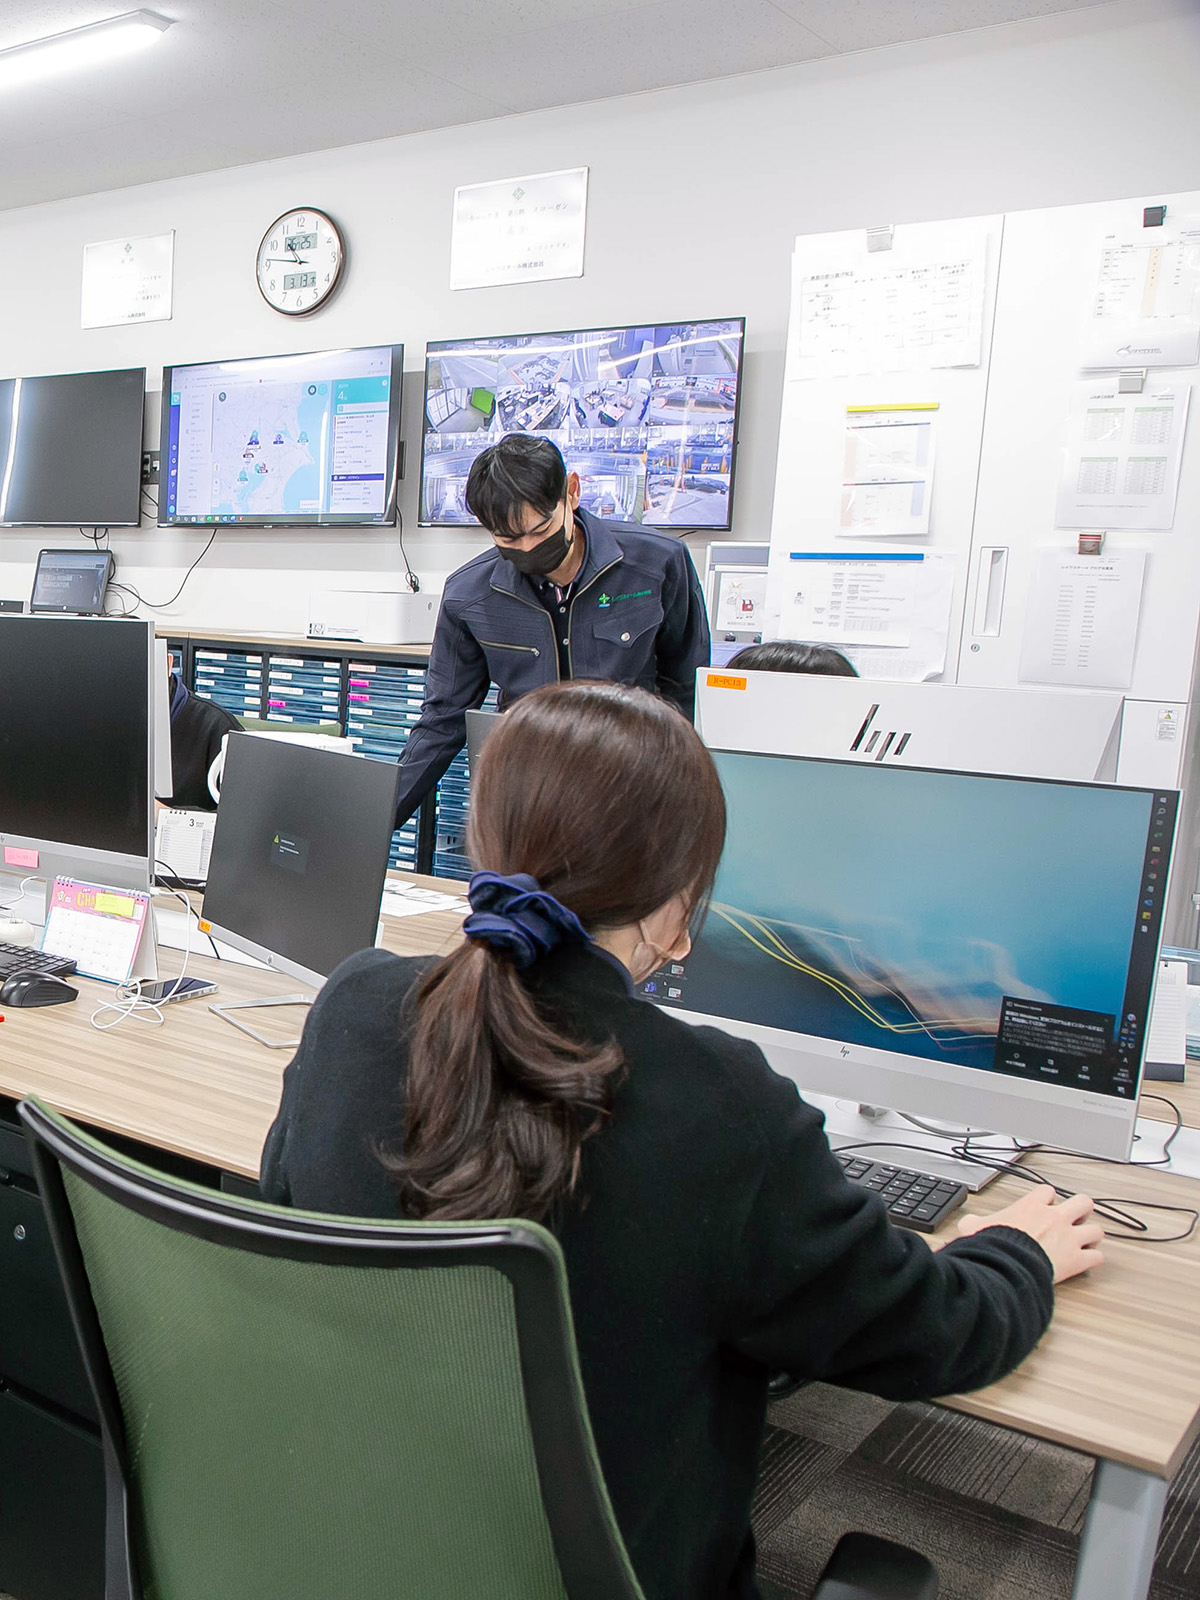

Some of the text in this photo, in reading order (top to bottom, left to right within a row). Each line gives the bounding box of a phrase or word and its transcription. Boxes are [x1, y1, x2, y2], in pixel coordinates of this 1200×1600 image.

[296, 215, 305, 228] 12
[282, 225, 289, 235] 11
[269, 240, 278, 251] 10
[330, 251, 337, 263] 3
[265, 260, 271, 272] 9
[324, 273, 330, 283] 4
[269, 279, 276, 291] 8
[282, 291, 288, 303] 7
[312, 288, 318, 299] 5
[296, 295, 302, 307] 6
[188, 818, 195, 827] 3
